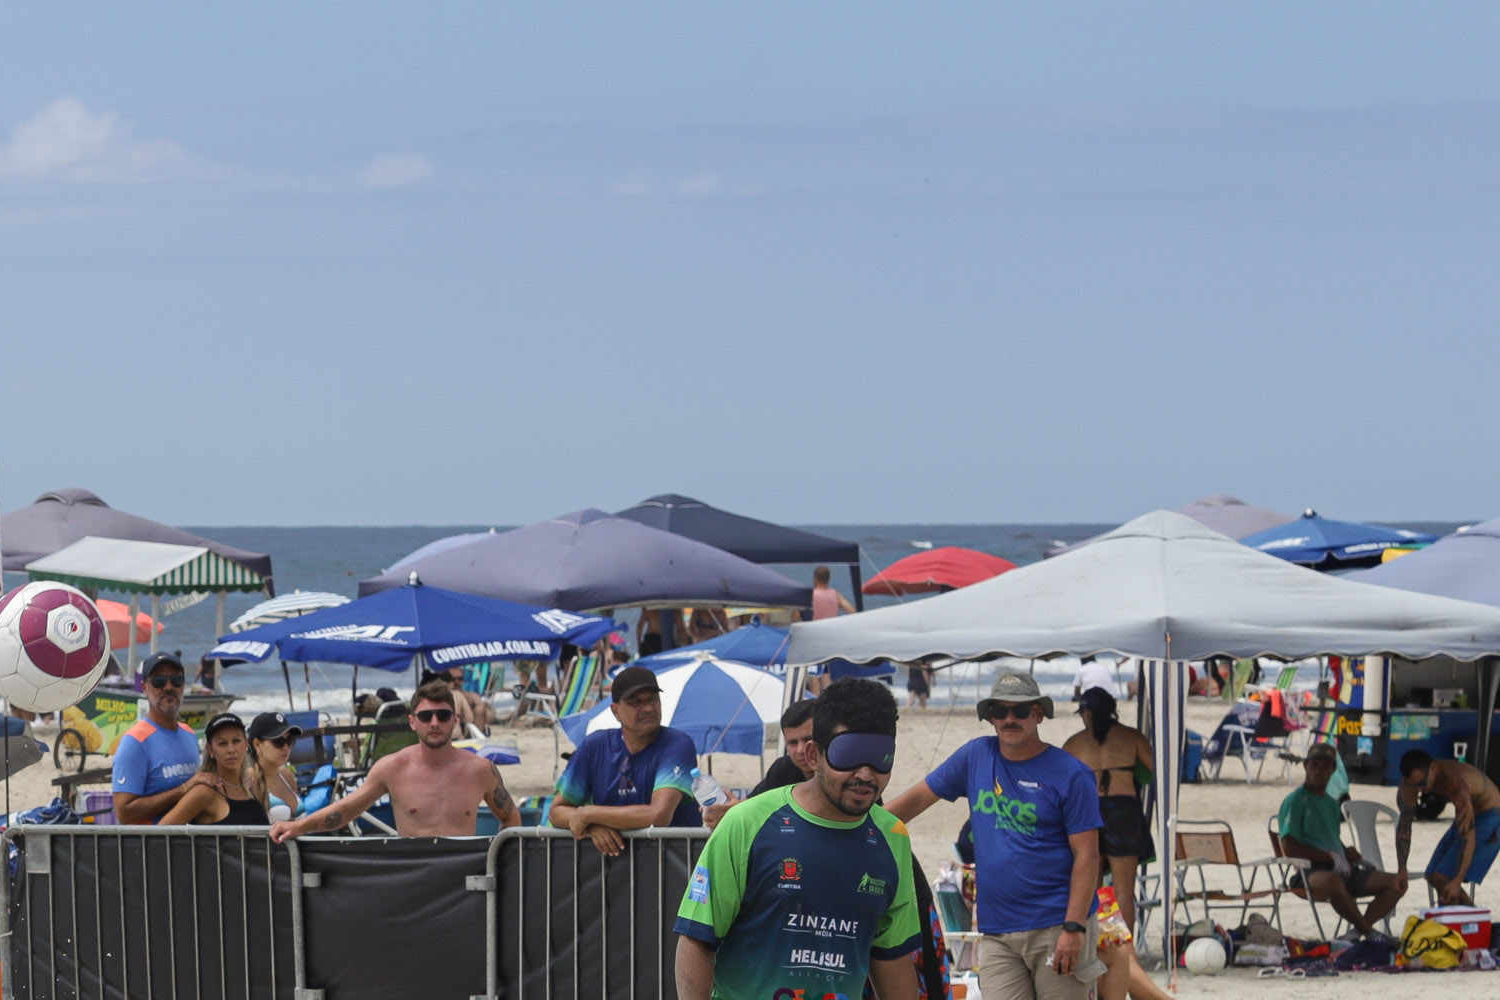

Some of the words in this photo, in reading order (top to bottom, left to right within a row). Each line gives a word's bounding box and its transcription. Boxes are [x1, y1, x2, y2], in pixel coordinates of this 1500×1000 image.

[973, 789, 1038, 825] JOGOS
[787, 913, 859, 934] ZINZANE
[790, 949, 846, 968] HELISUL
